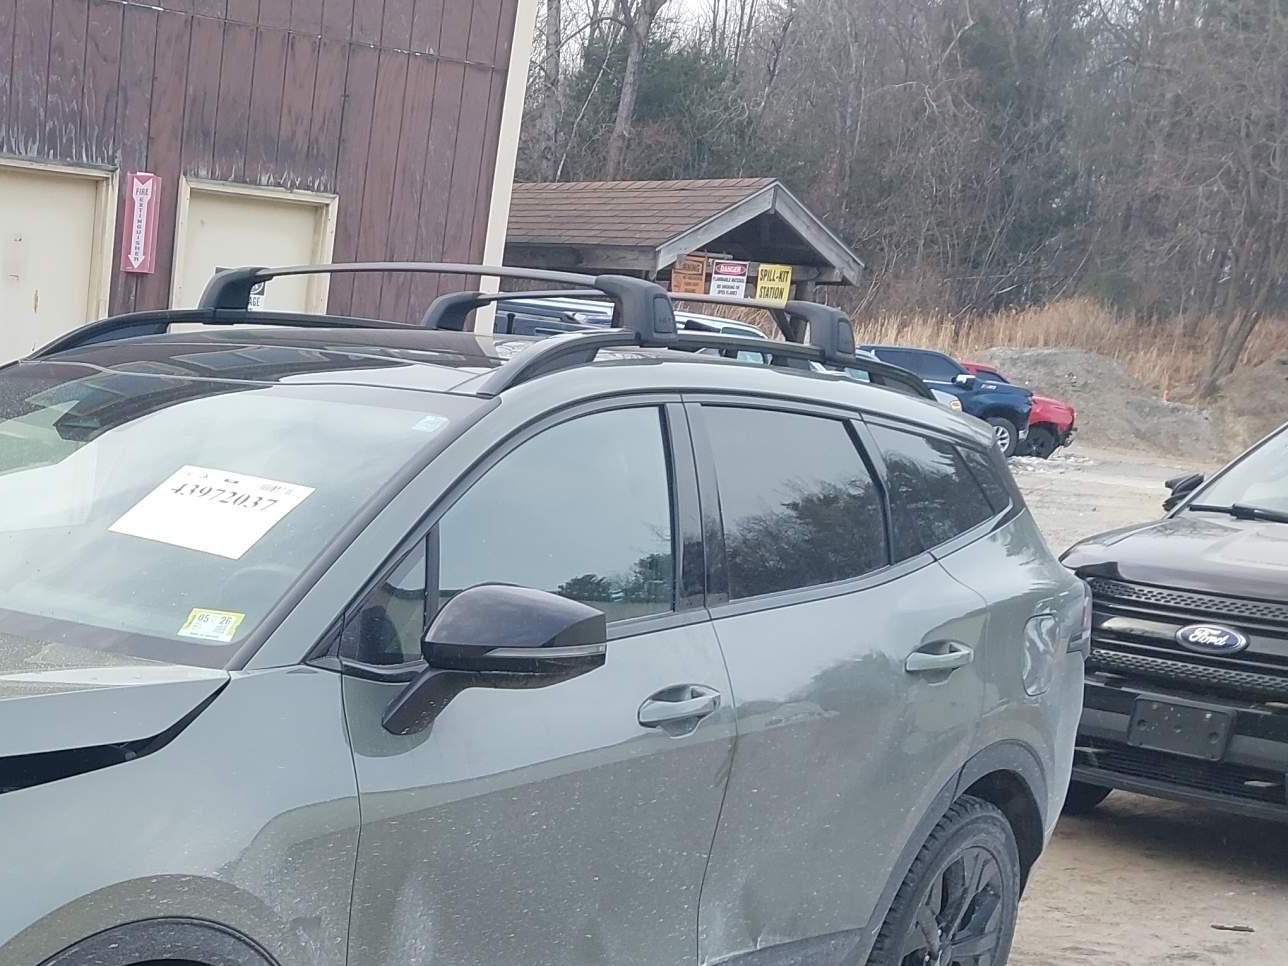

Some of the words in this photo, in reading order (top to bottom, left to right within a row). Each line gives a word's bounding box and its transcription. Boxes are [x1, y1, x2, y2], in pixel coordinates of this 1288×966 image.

[719, 265, 742, 274] DANGER
[759, 268, 790, 282] SPILL-KIT
[759, 286, 785, 300] STATION
[170, 482, 279, 511] 43972037
[1189, 628, 1229, 646] Ford
